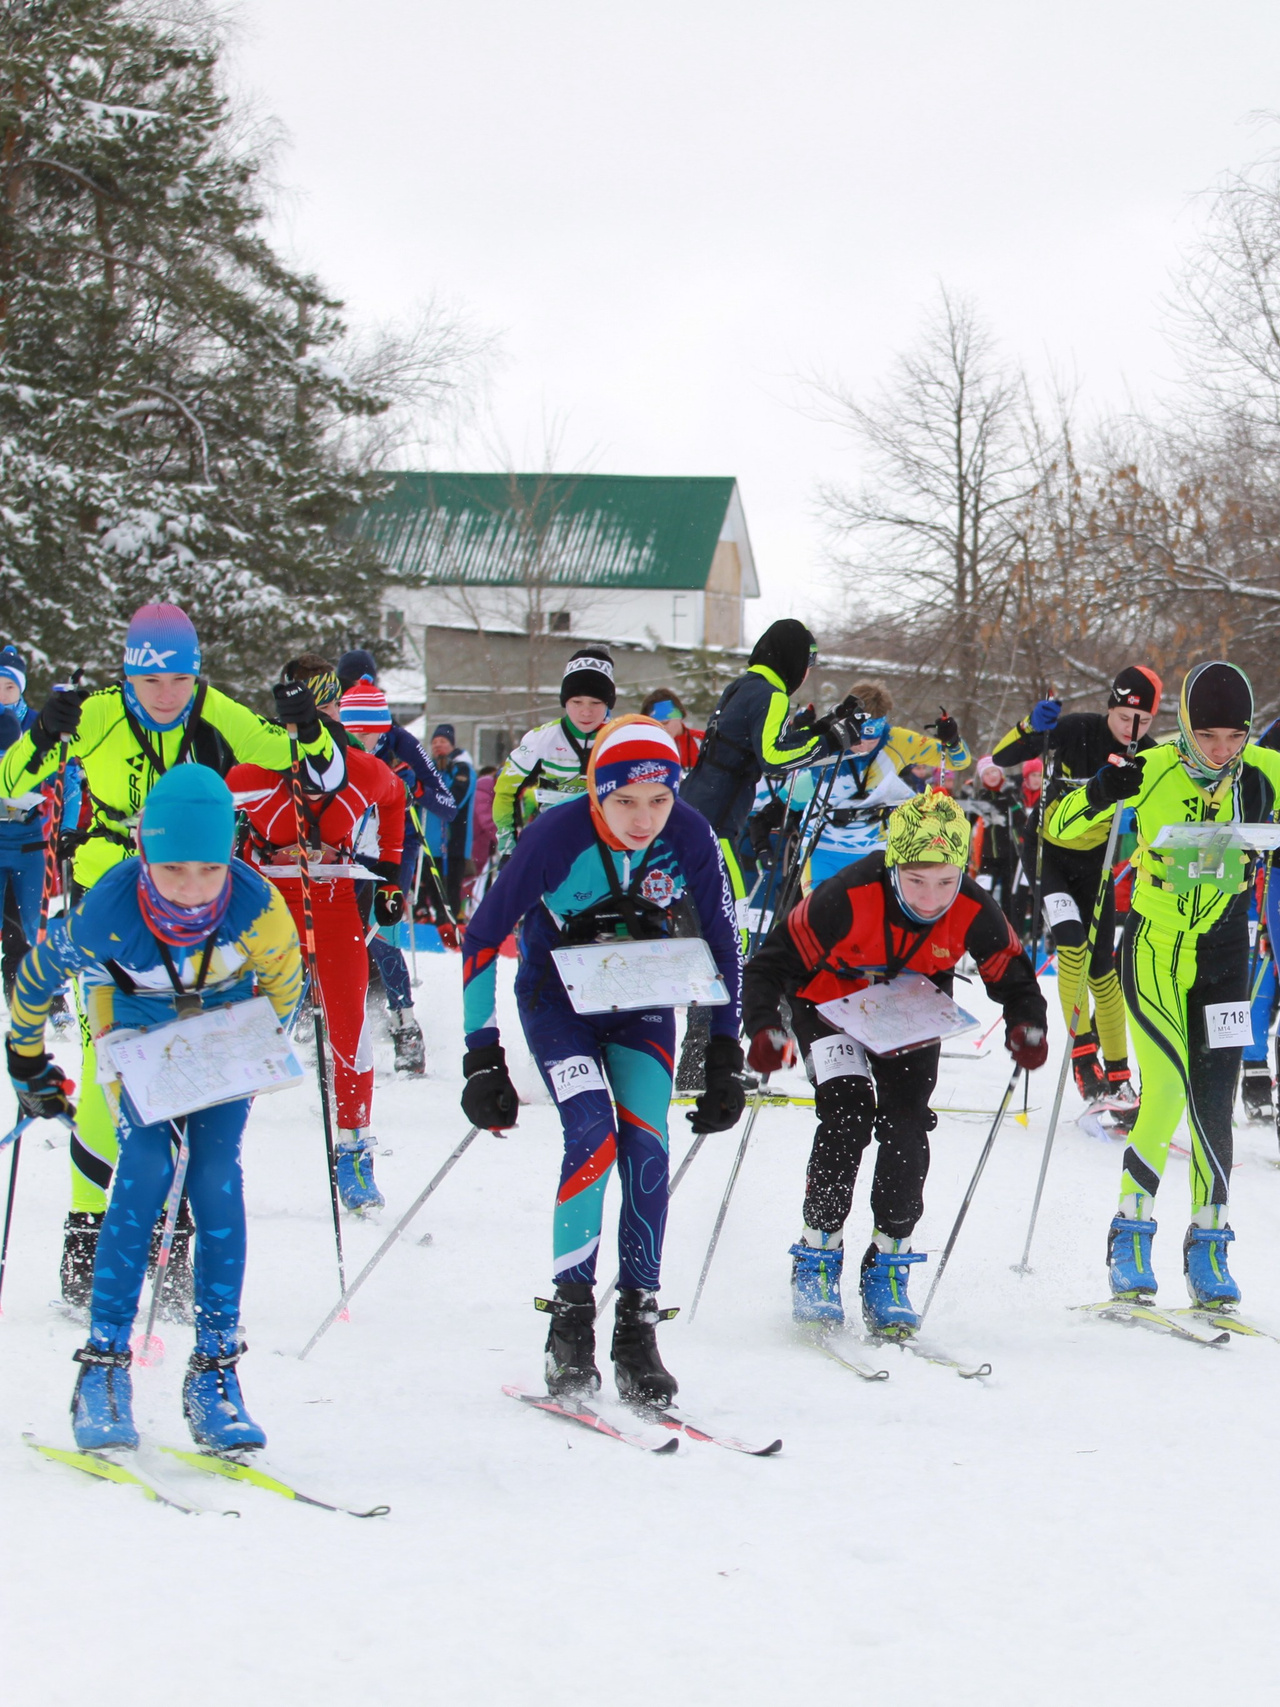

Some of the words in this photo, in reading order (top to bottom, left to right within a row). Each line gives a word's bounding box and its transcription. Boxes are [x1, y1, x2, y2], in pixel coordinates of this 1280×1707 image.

[1053, 899, 1072, 908] 737
[1220, 1011, 1244, 1025] 718
[826, 1044, 854, 1058] 719
[557, 1063, 589, 1084] 720
[79, 1353, 115, 1364] SPINE
